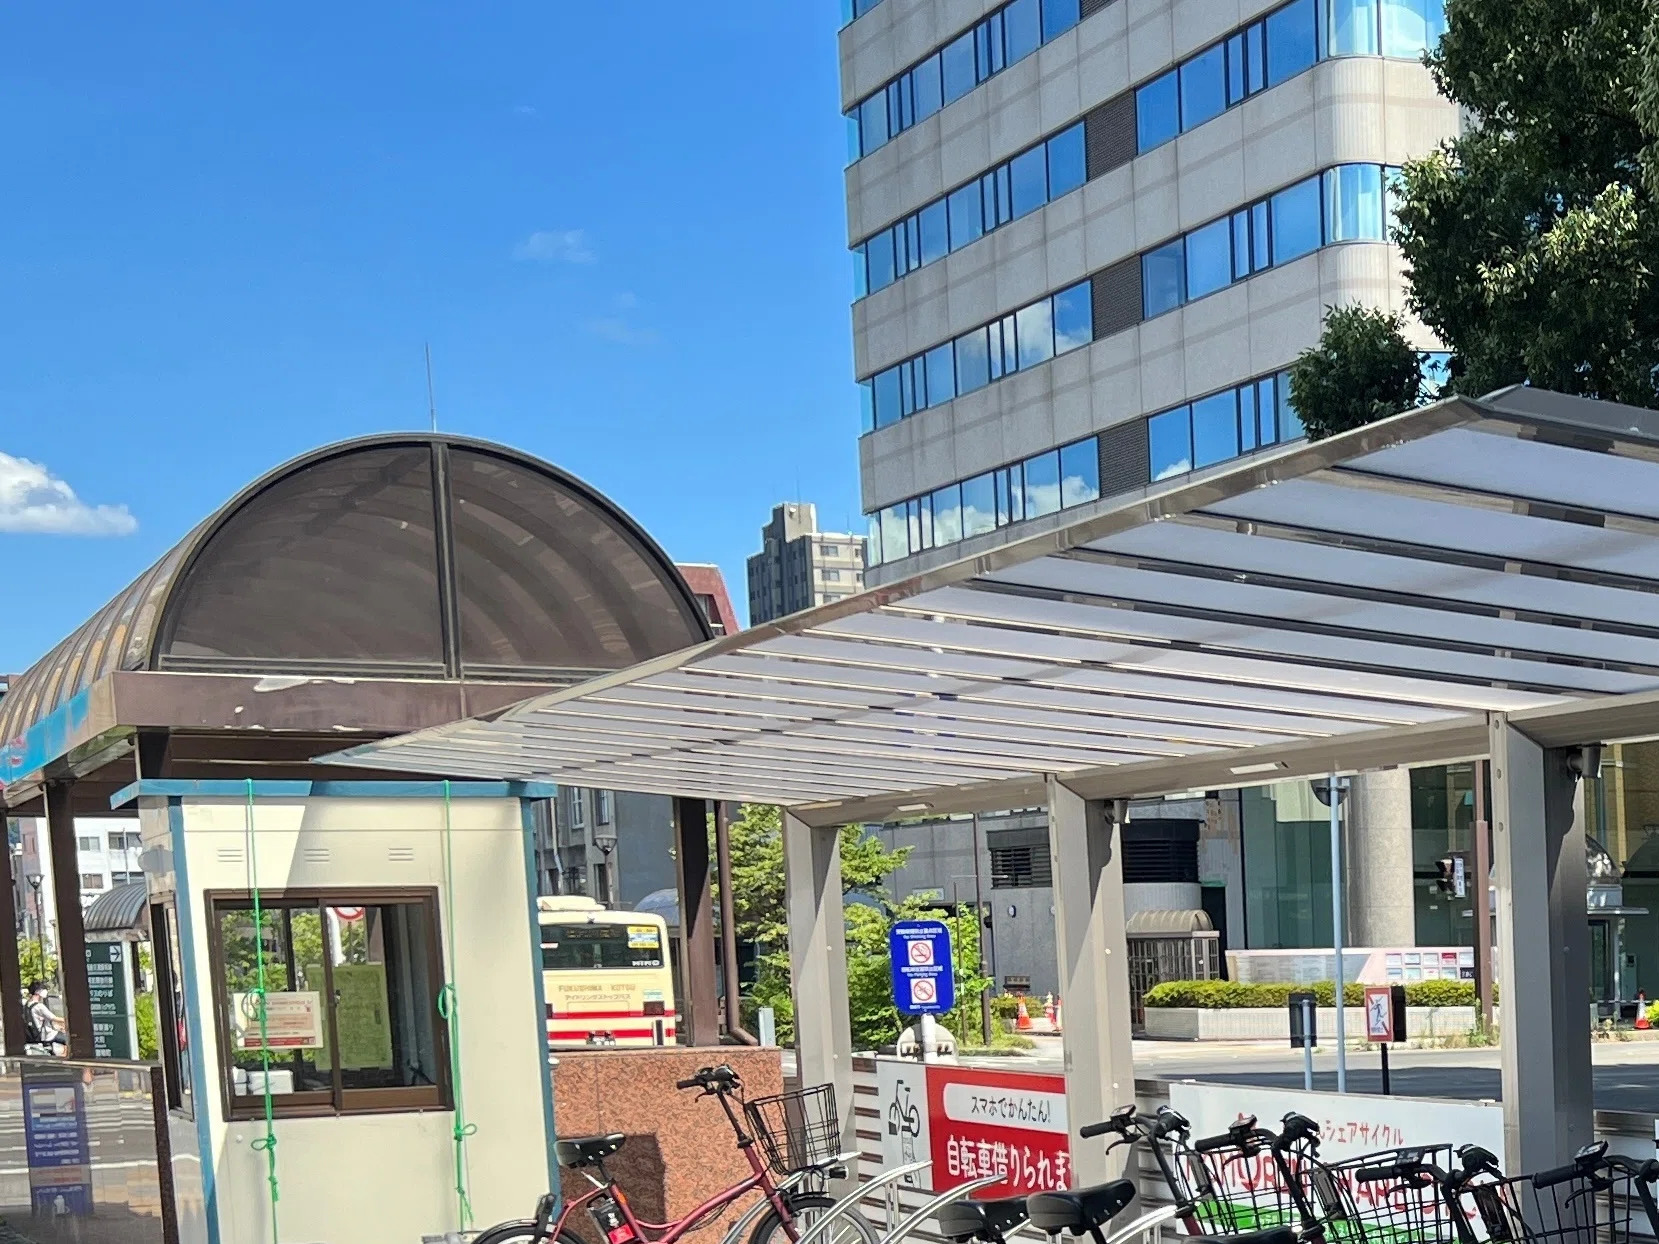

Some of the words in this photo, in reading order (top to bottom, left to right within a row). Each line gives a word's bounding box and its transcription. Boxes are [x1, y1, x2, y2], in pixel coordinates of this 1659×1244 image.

[946, 1133, 1070, 1192] 自転車借りられま
